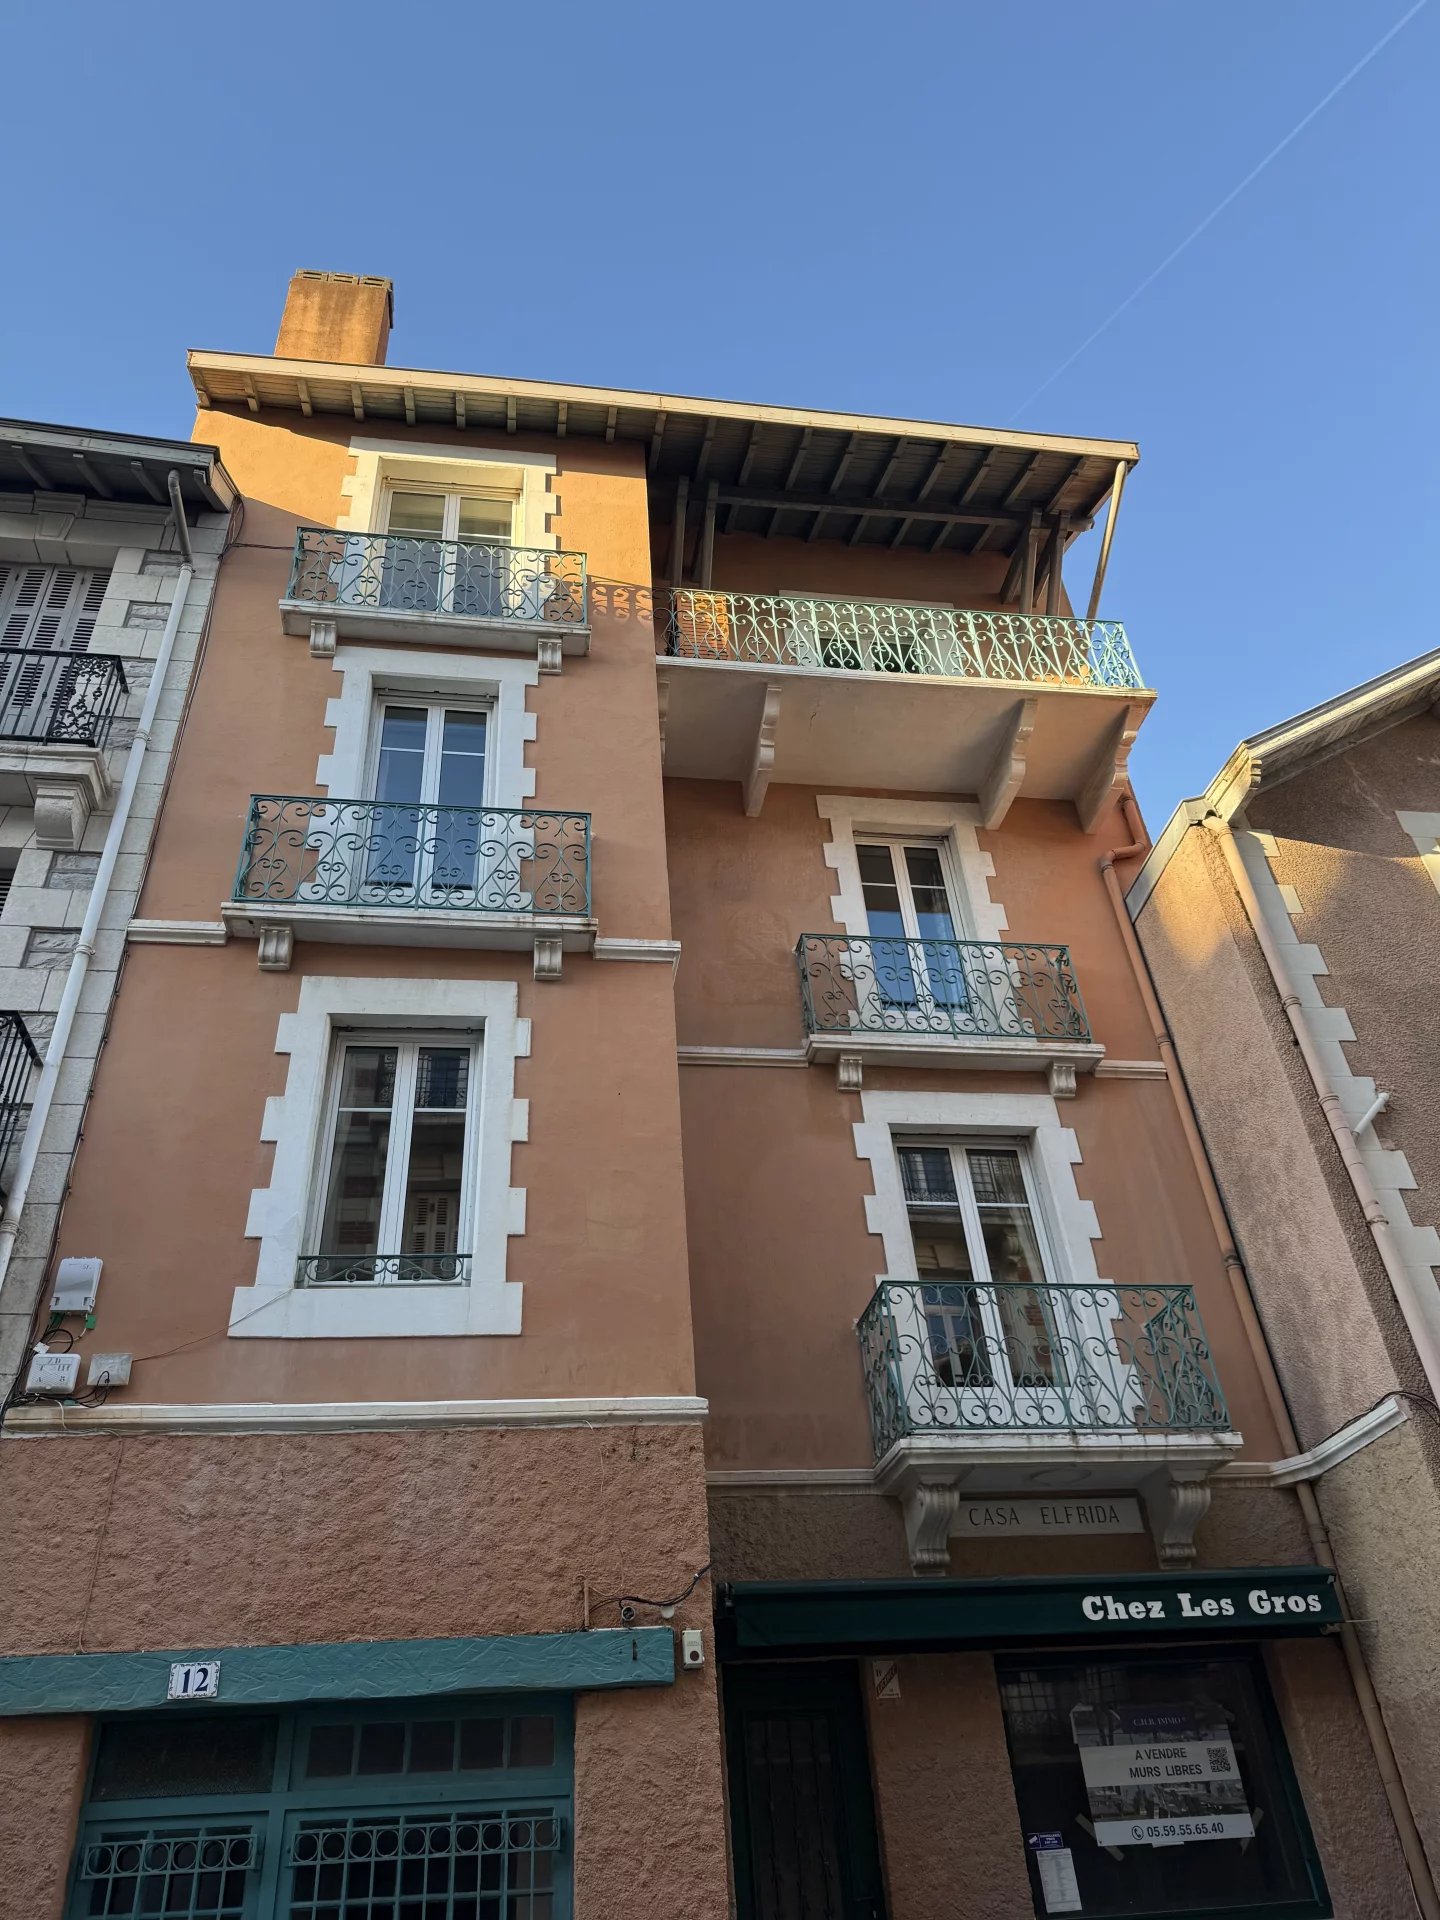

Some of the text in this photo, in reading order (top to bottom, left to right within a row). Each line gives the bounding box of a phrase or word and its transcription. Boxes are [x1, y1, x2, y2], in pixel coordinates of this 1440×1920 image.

[968, 1505, 1120, 1526] CASA ELFRIDA
[1082, 1589, 1322, 1621] Chez Les Gros
[182, 1667, 209, 1694] 12
[1135, 1747, 1188, 1761] A VENDRE
[1129, 1764, 1203, 1779] MURS LIBRES
[1146, 1822, 1225, 1838] 05.59.55.65.40
